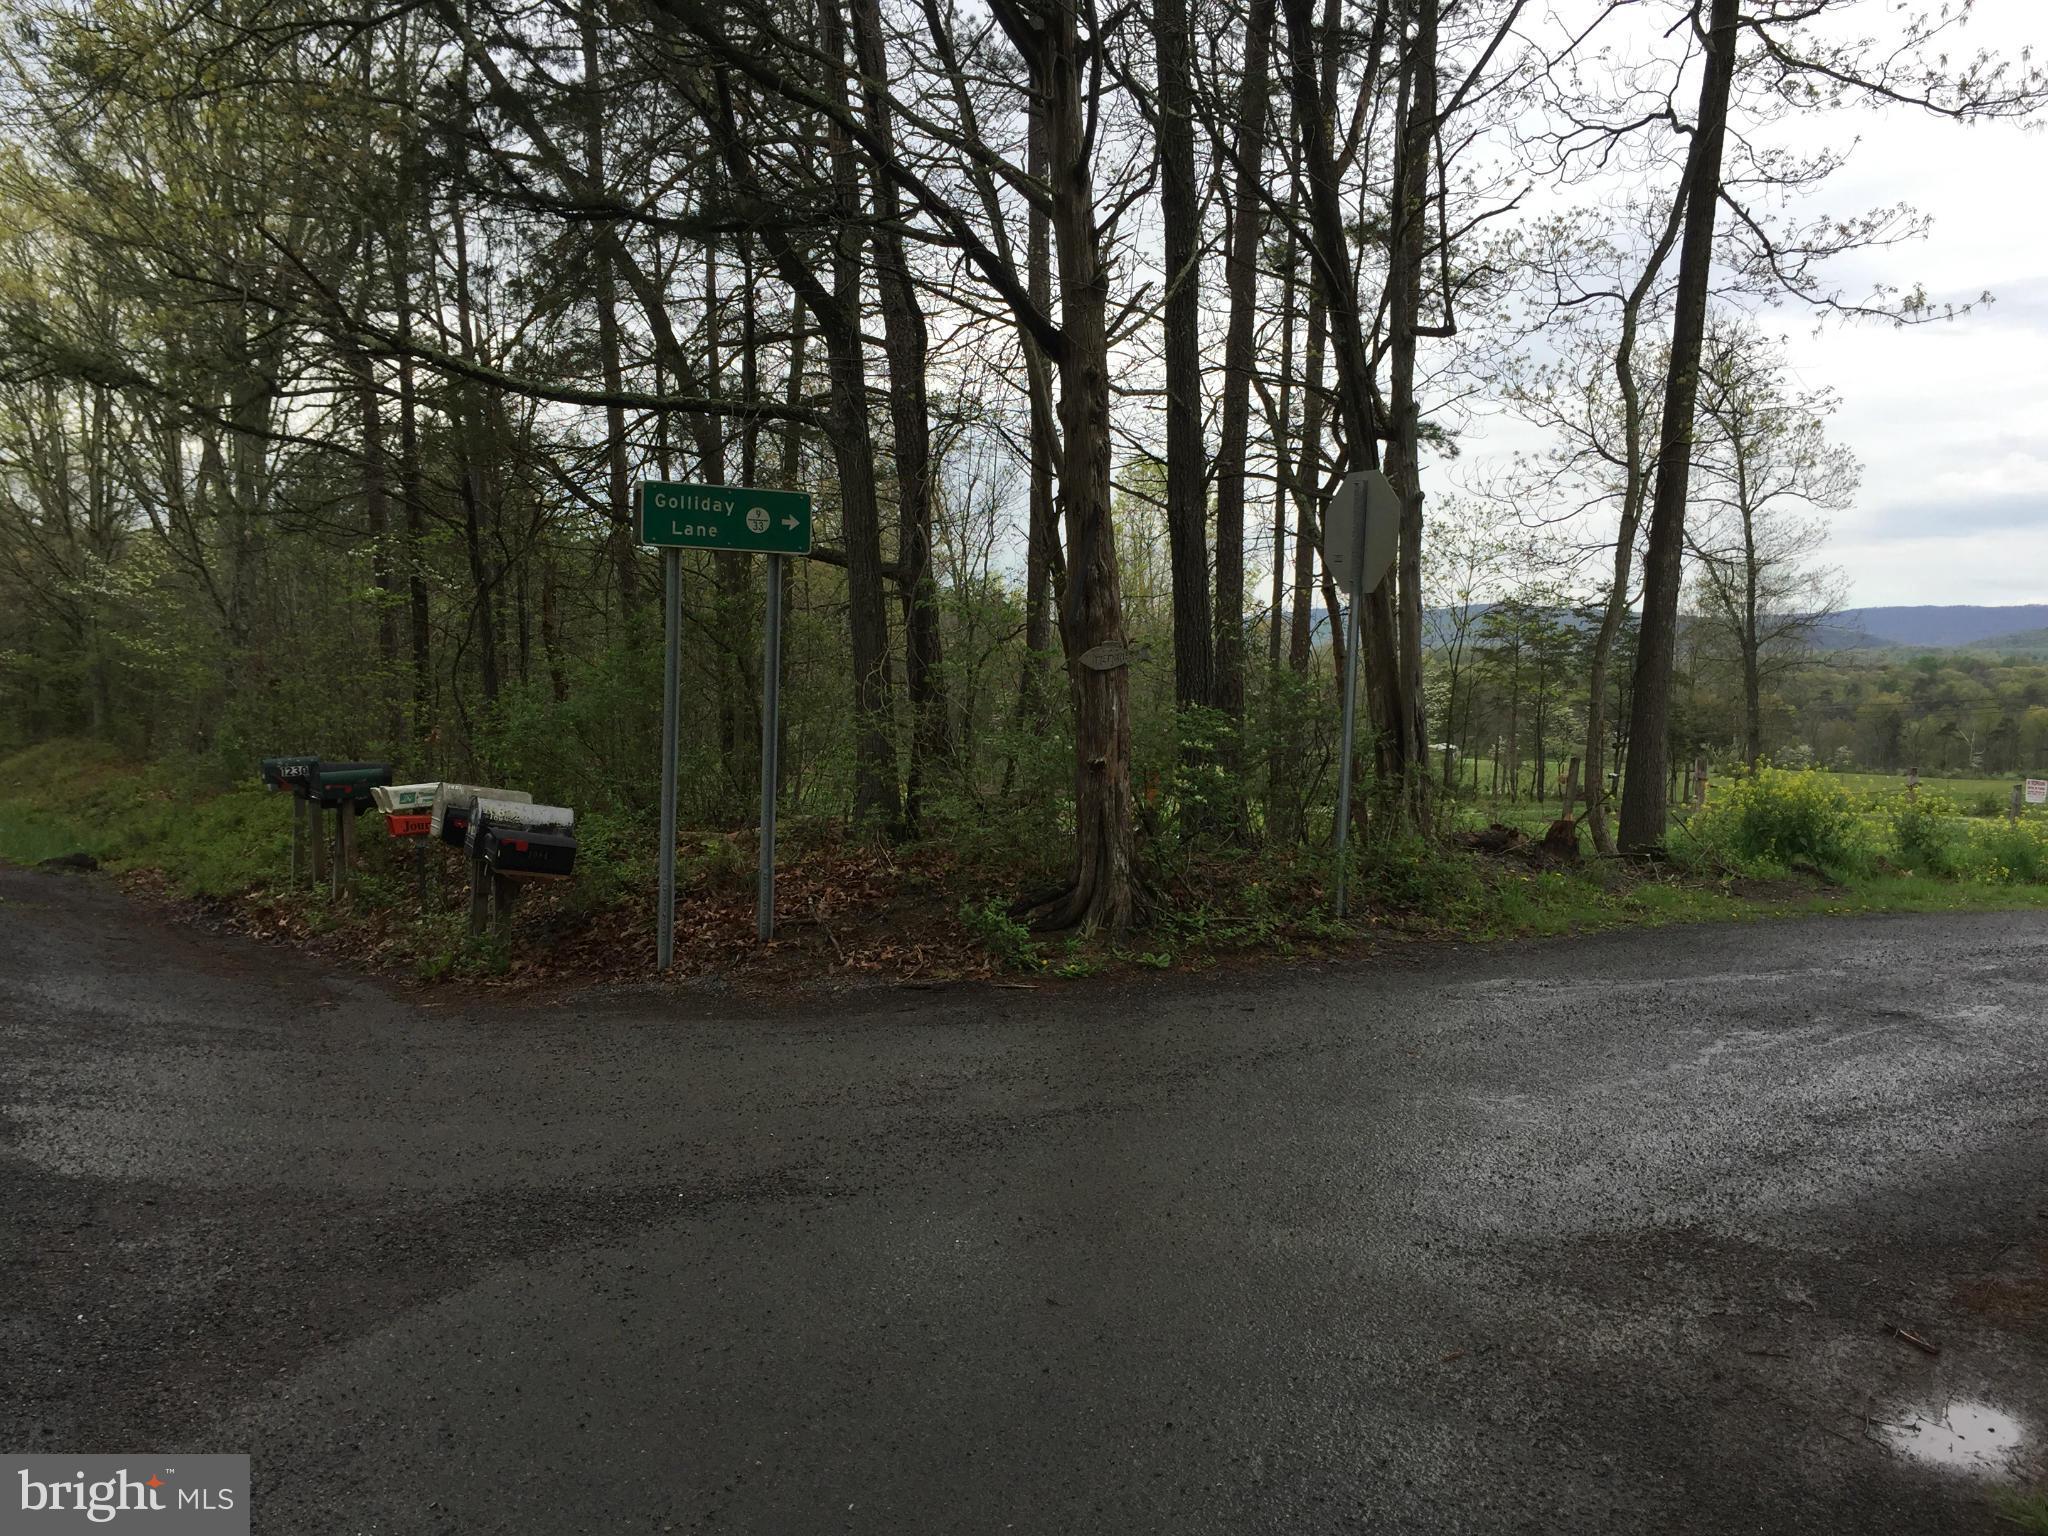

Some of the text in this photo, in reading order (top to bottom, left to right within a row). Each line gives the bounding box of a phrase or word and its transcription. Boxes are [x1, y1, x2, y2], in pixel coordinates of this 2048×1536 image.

[655, 493, 735, 516] Golliday
[755, 510, 761, 518] 9
[672, 520, 718, 537] Lane
[752, 521, 764, 532] 33
